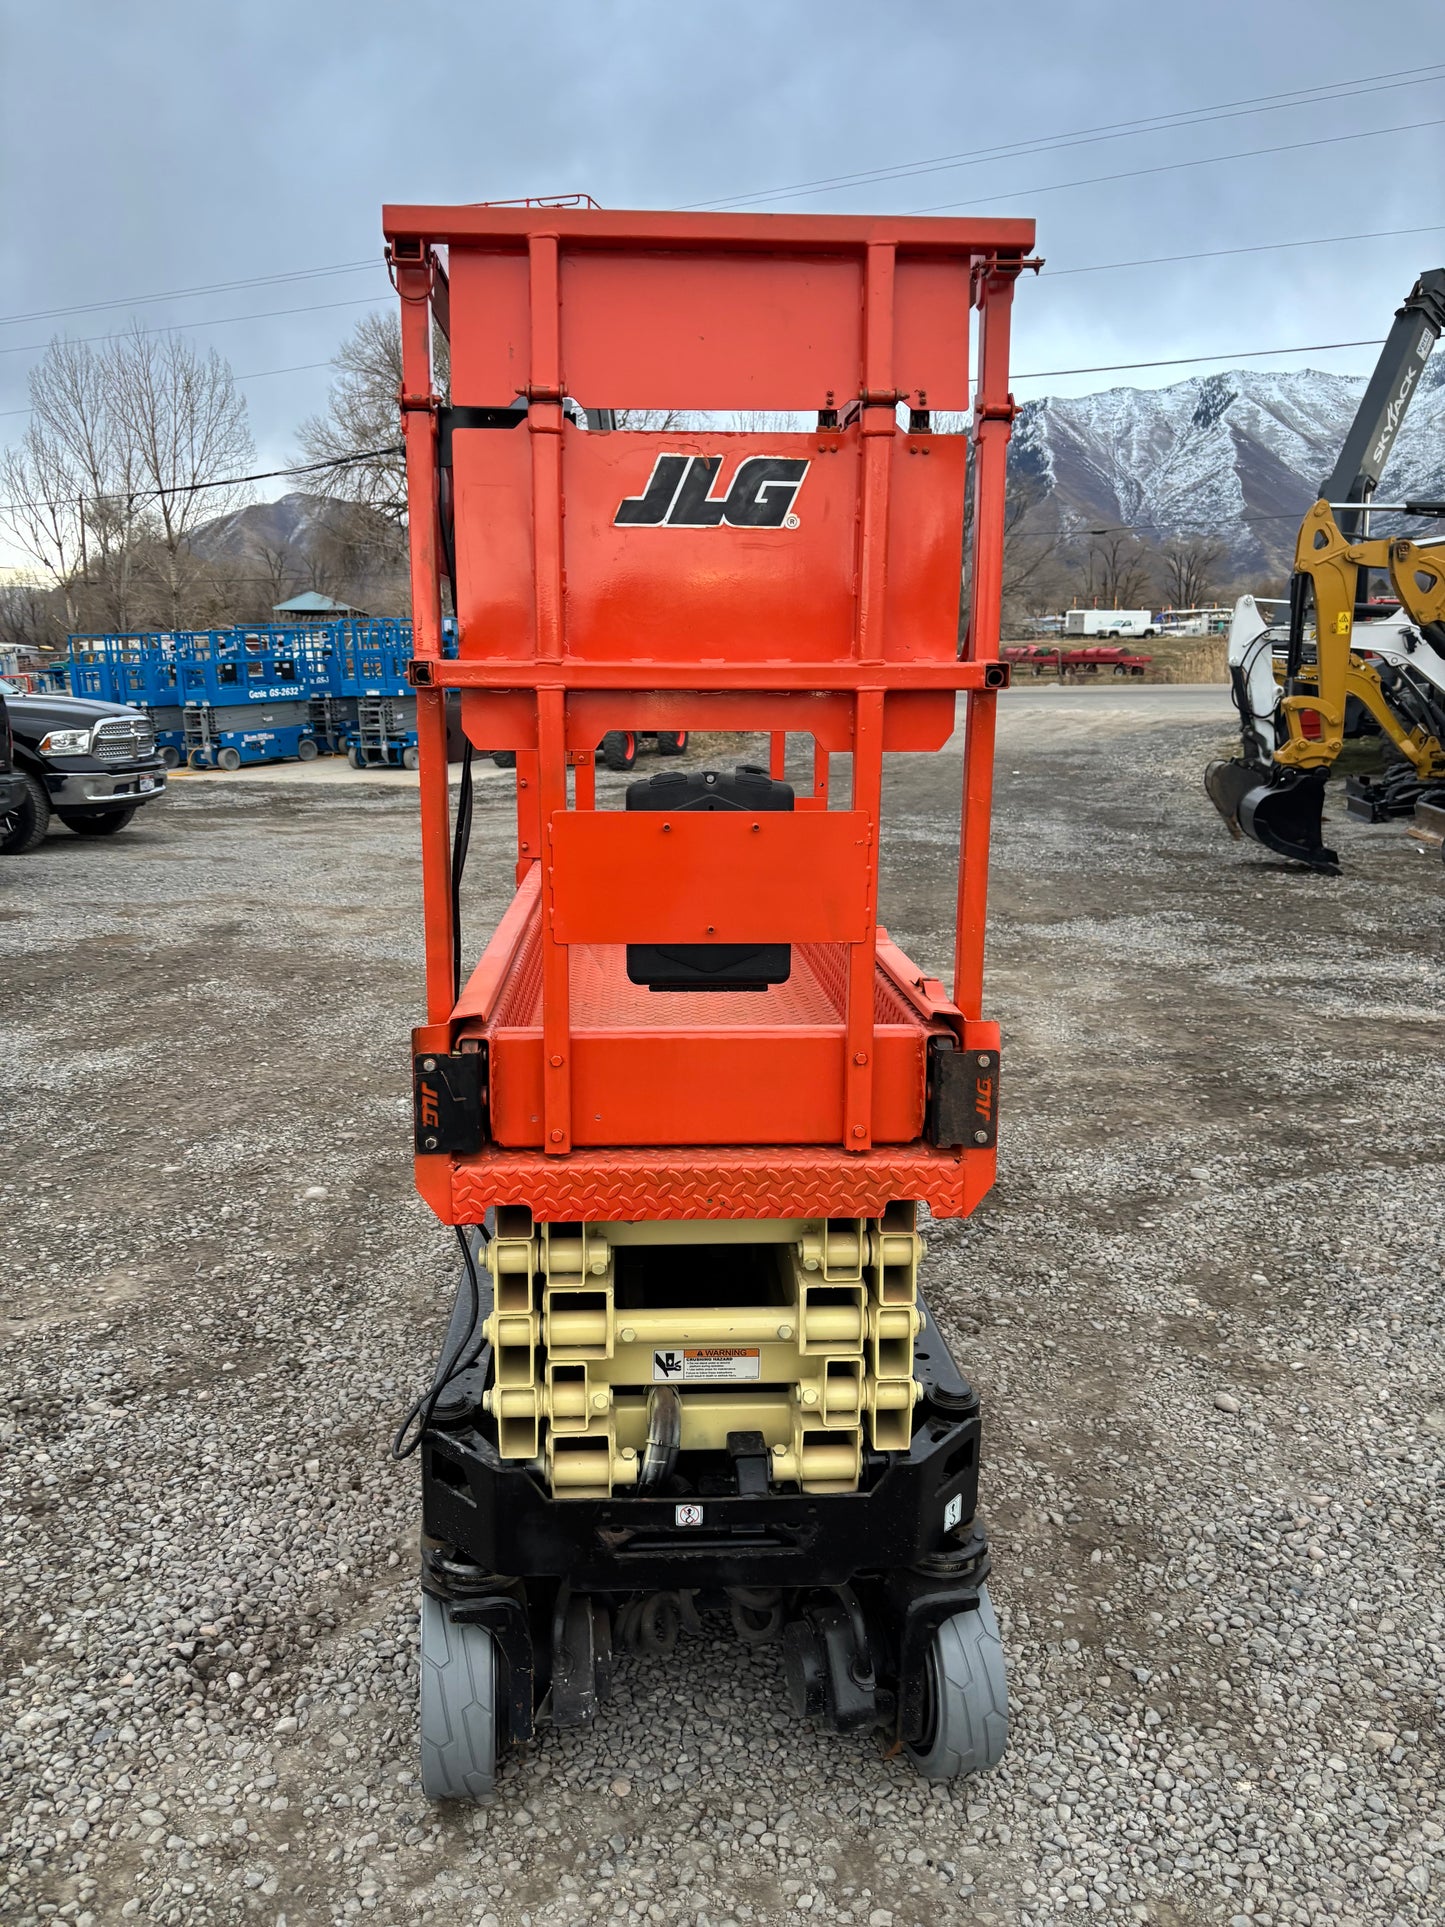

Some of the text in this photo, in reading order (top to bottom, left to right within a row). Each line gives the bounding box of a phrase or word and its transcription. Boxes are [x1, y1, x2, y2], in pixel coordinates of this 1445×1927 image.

[1373, 365, 1417, 464] SKYJACK
[249, 687, 298, 698] Genie GS-2632
[421, 1082, 439, 1128] JLG
[975, 1077, 992, 1121] JLG
